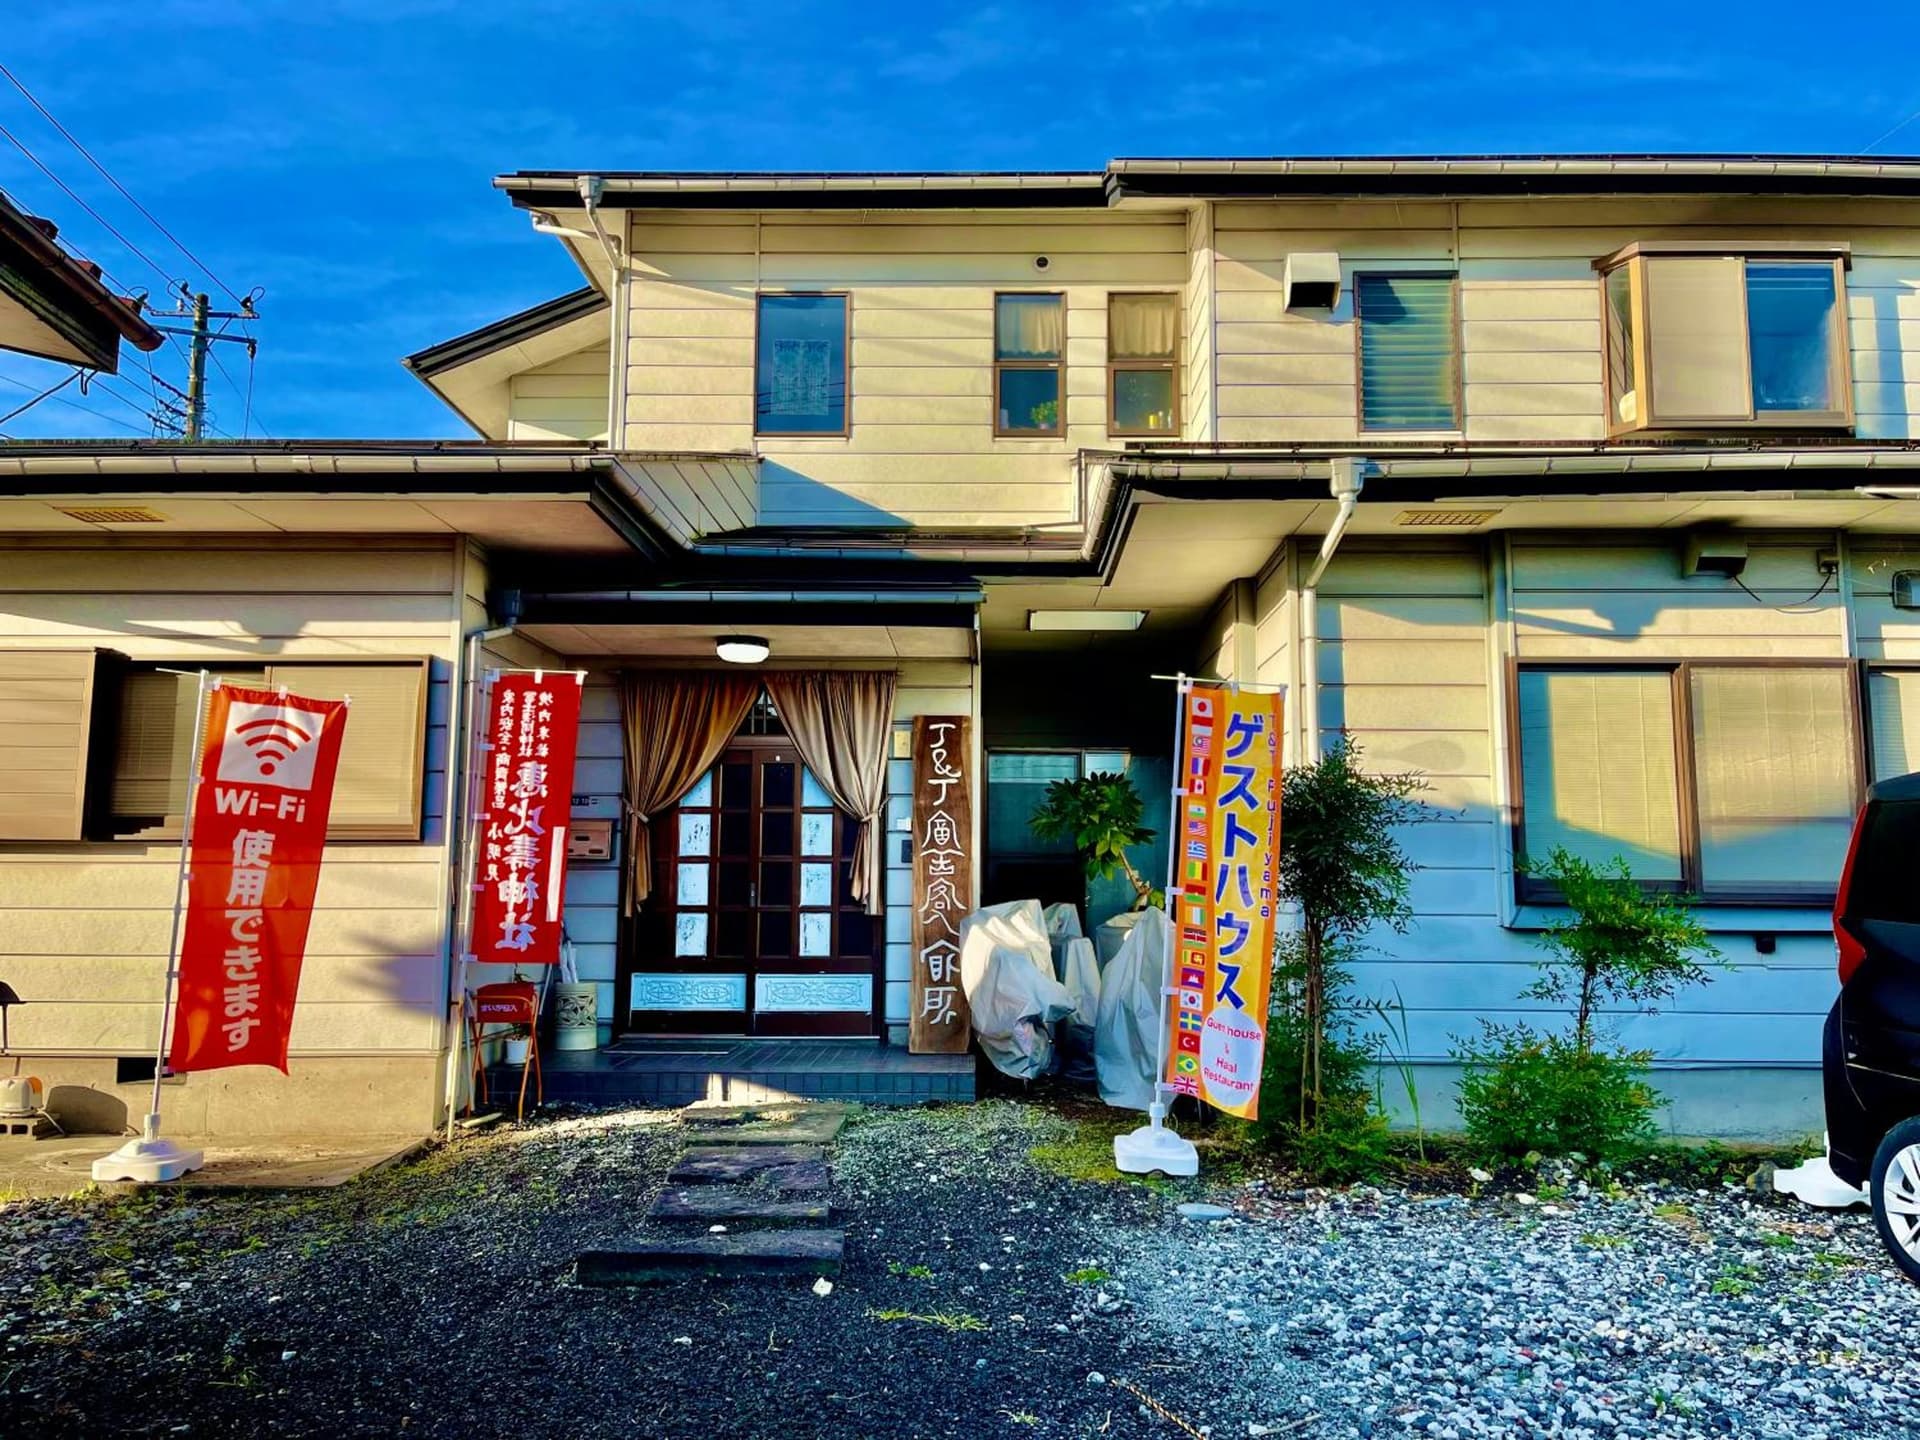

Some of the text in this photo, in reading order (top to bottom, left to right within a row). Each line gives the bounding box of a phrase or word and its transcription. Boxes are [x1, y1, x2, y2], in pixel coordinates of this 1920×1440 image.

[214, 787, 306, 823] Wi-Fi
[1216, 711, 1263, 1010] ゲストハウス
[1260, 779, 1276, 918] Fujiyama
[221, 828, 276, 1052] 使用できます
